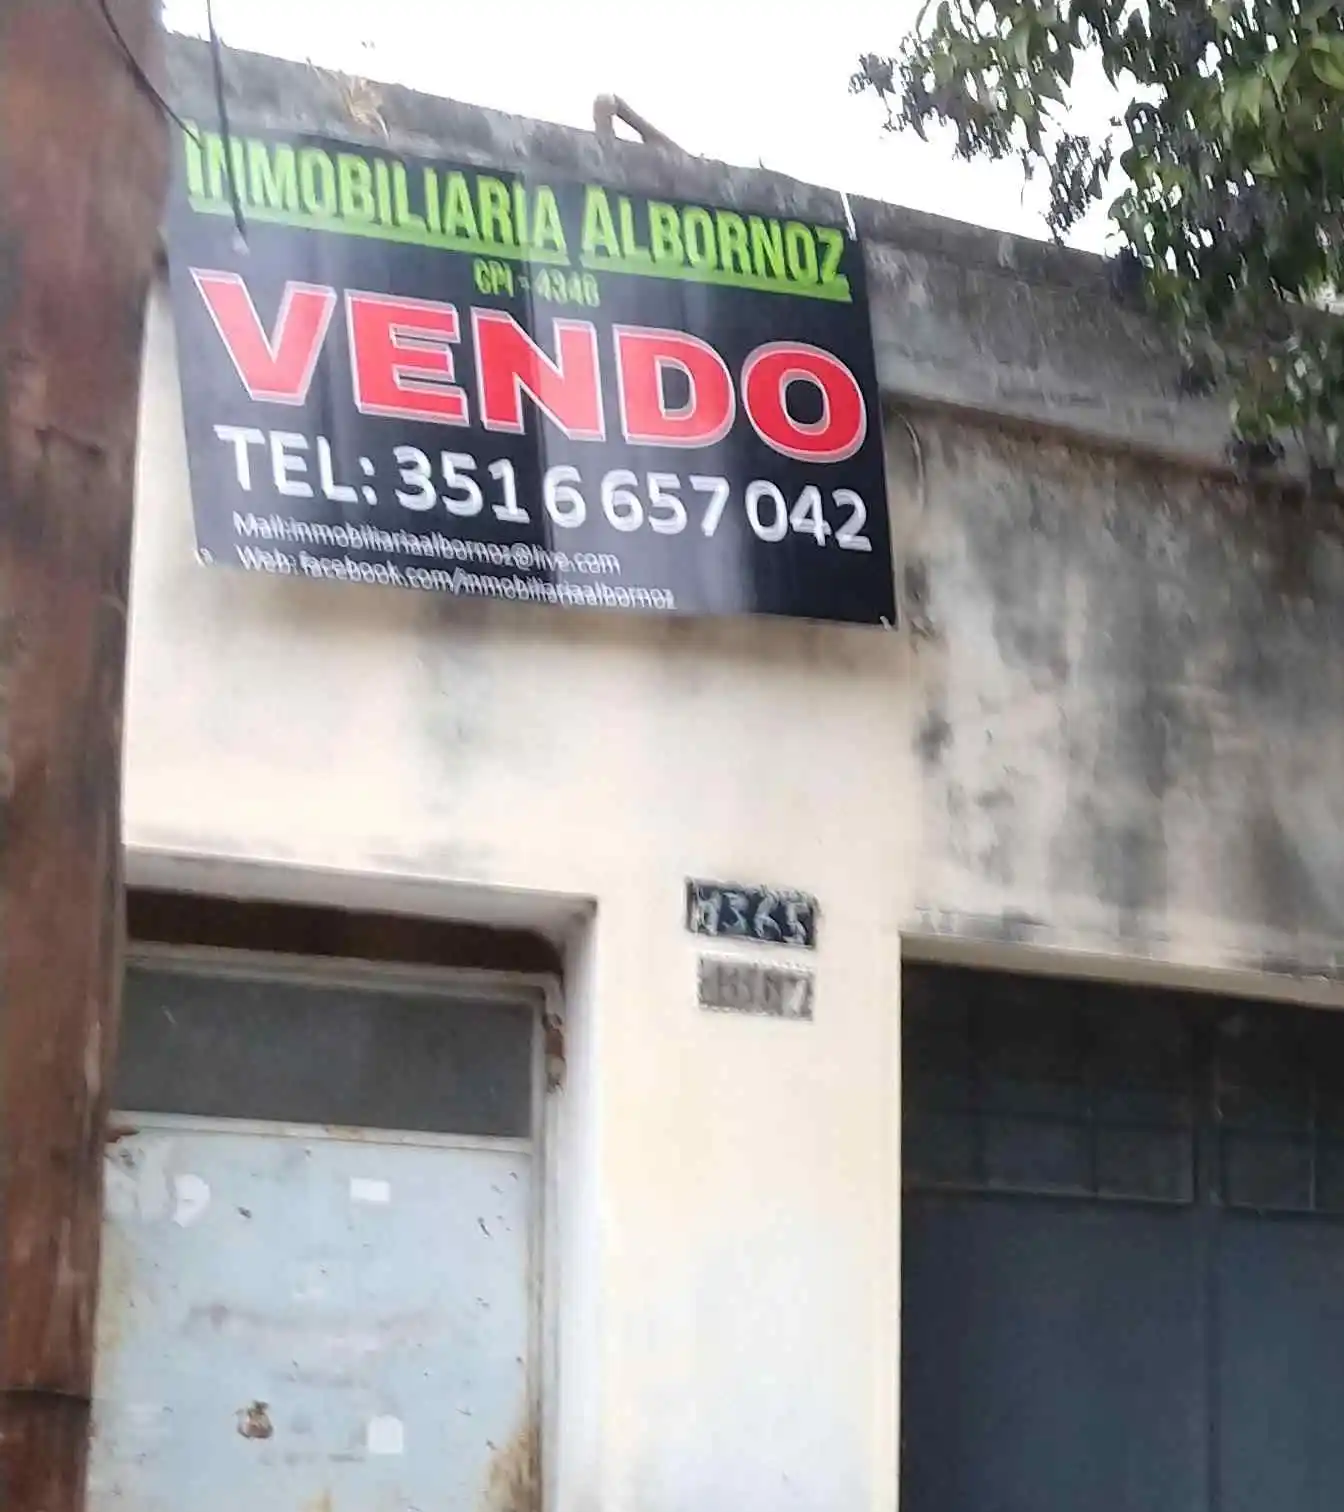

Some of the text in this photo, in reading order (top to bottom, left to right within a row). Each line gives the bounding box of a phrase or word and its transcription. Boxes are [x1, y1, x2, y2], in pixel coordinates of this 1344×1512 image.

[184, 120, 847, 286] INMOBILIARIA ALBORNOZ
[473, 258, 514, 298] CPI
[188, 266, 868, 464] VENDO
[212, 424, 378, 506] TEL:
